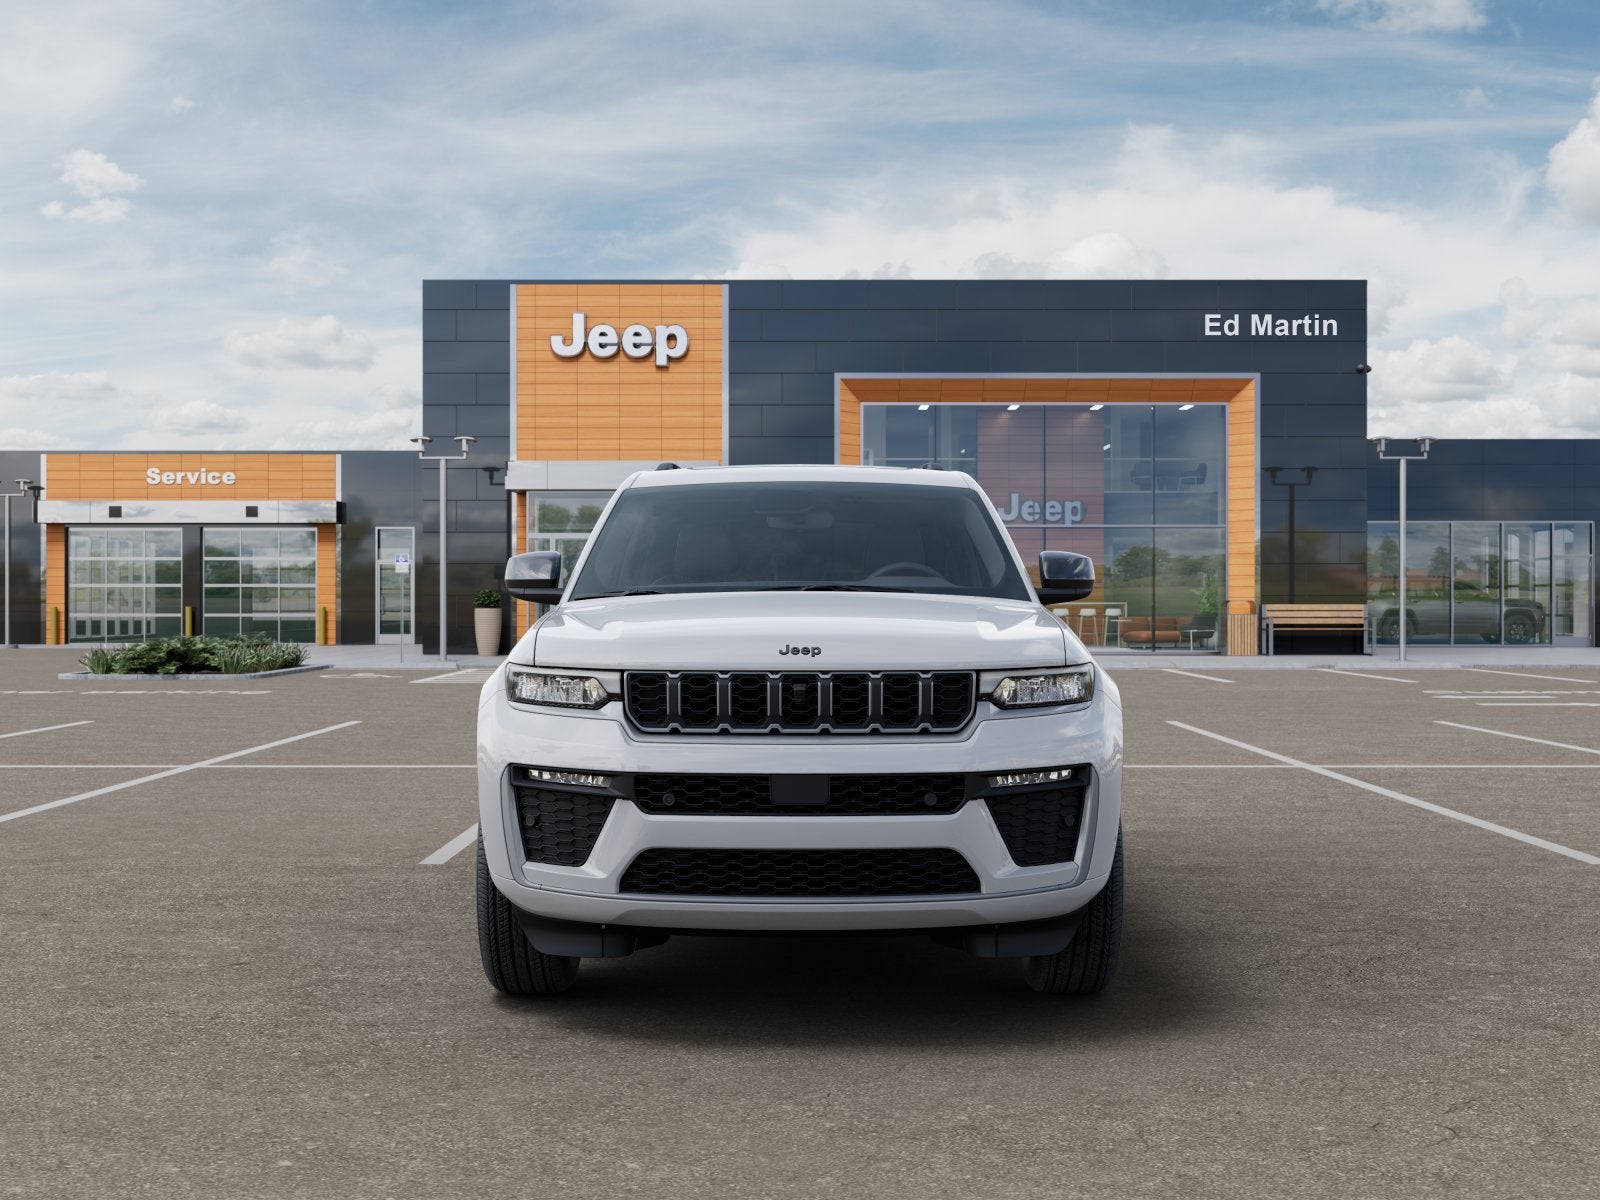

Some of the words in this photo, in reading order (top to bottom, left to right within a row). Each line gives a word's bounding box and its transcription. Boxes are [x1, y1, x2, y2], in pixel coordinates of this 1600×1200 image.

[1204, 313, 1240, 336] Ed
[1250, 313, 1338, 336] Martin
[550, 312, 689, 368] Jeep
[146, 467, 236, 485] Service
[997, 492, 1083, 526] Jeep
[778, 644, 822, 658] Jeep
